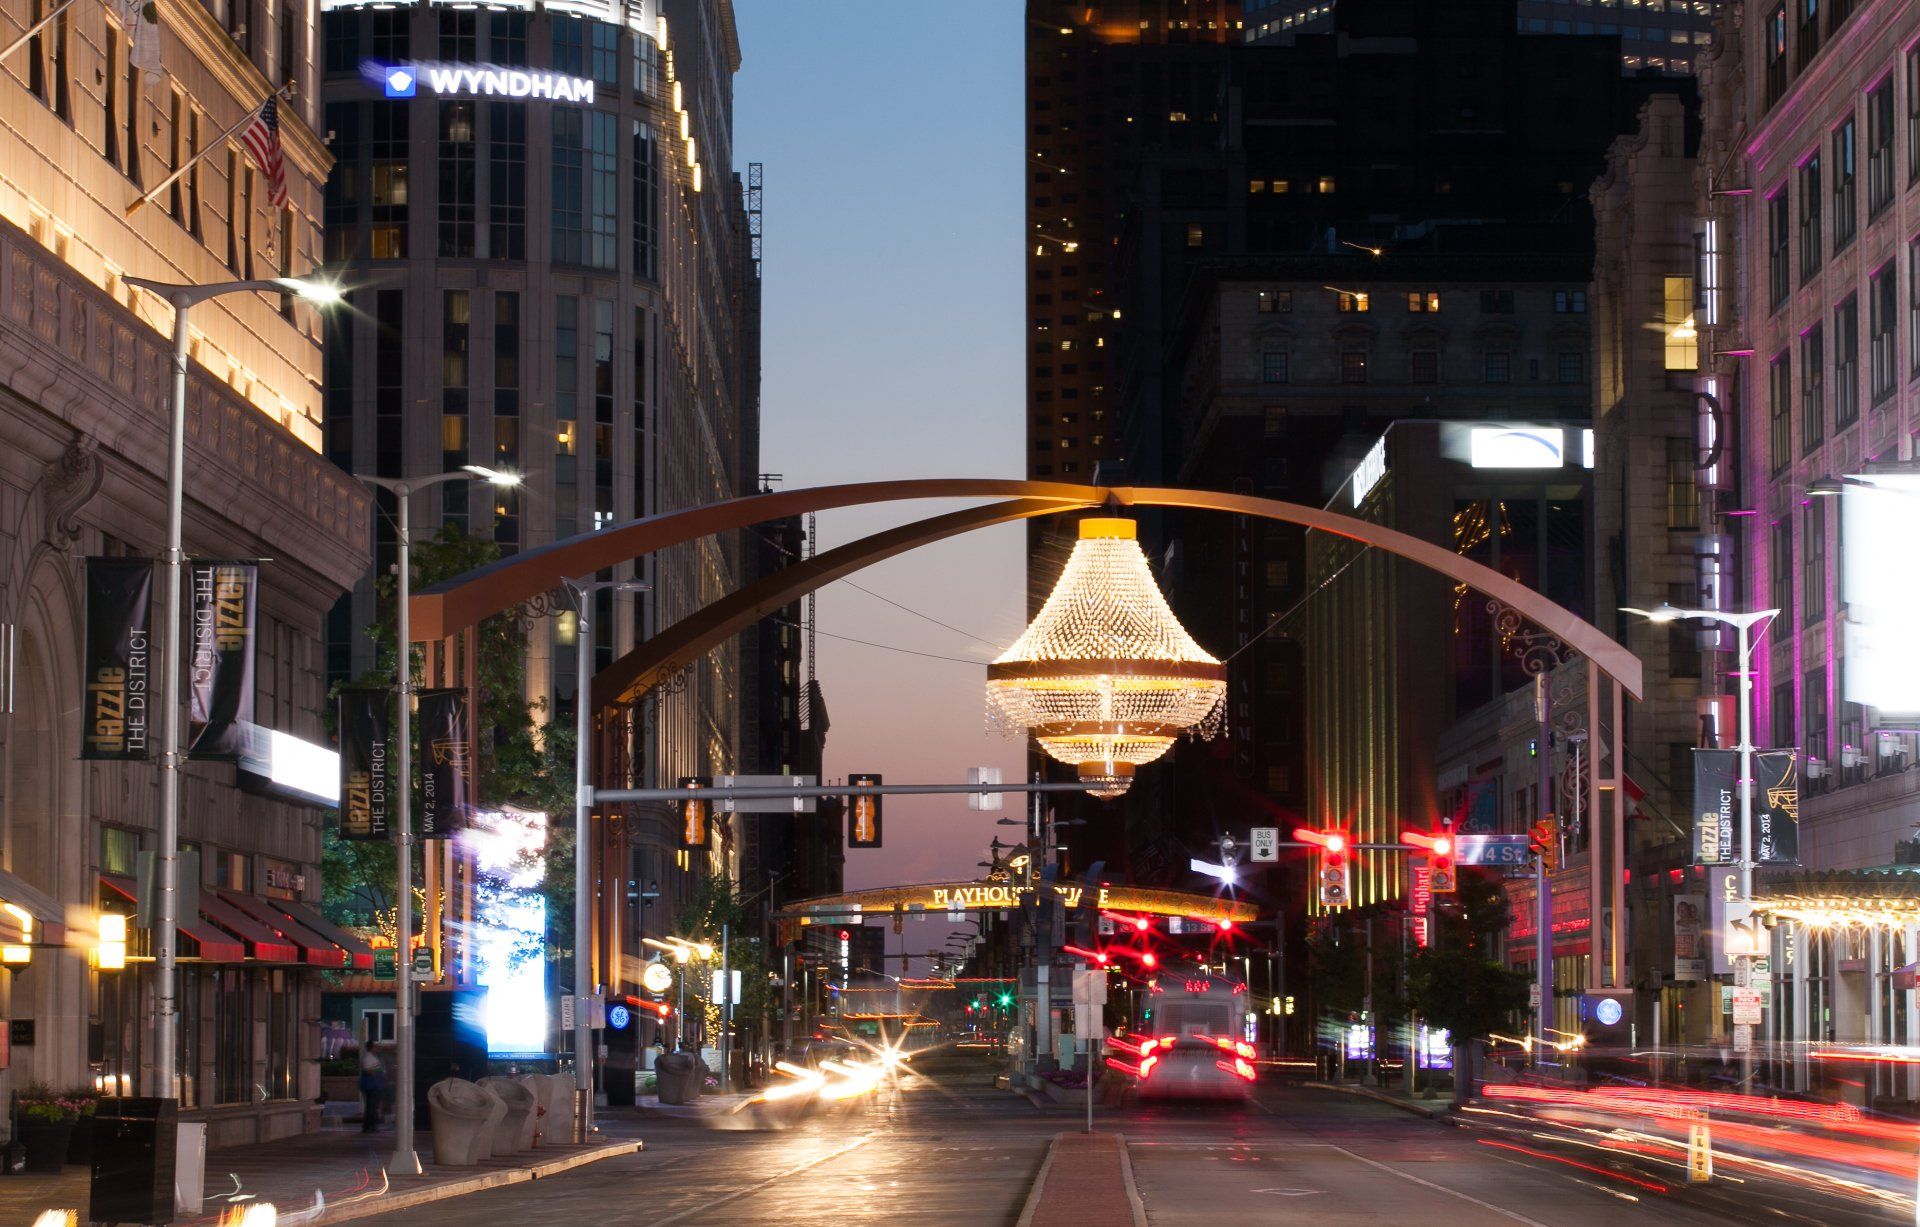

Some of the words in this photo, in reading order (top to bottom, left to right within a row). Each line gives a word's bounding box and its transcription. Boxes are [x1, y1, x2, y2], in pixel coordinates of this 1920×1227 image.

[430, 69, 594, 104] WYNDHAM
[196, 567, 213, 603] THE
[215, 567, 253, 651] dazzle
[128, 627, 147, 709] DISTRICT
[196, 610, 213, 691] DISTRICT
[87, 667, 126, 751] dazzle
[1238, 678, 1250, 765] ARMS
[128, 716, 145, 752] THE
[372, 741, 385, 804] DISTRICT
[425, 773, 434, 797] 2014
[343, 770, 370, 834] dazzle
[426, 800, 435, 809] 2,
[1720, 789, 1732, 837] DISTRICT
[372, 807, 385, 834] THE
[425, 813, 434, 833] MAY
[1256, 831, 1272, 839] BUS
[1696, 812, 1719, 861] dazzle
[1762, 814, 1770, 833] 2014
[1255, 840, 1273, 848] ONLY
[1720, 840, 1731, 861] THE
[1762, 845, 1770, 860] MAY
[1763, 835, 1771, 843] 2,
[933, 886, 1034, 904] PLAYHOUS
